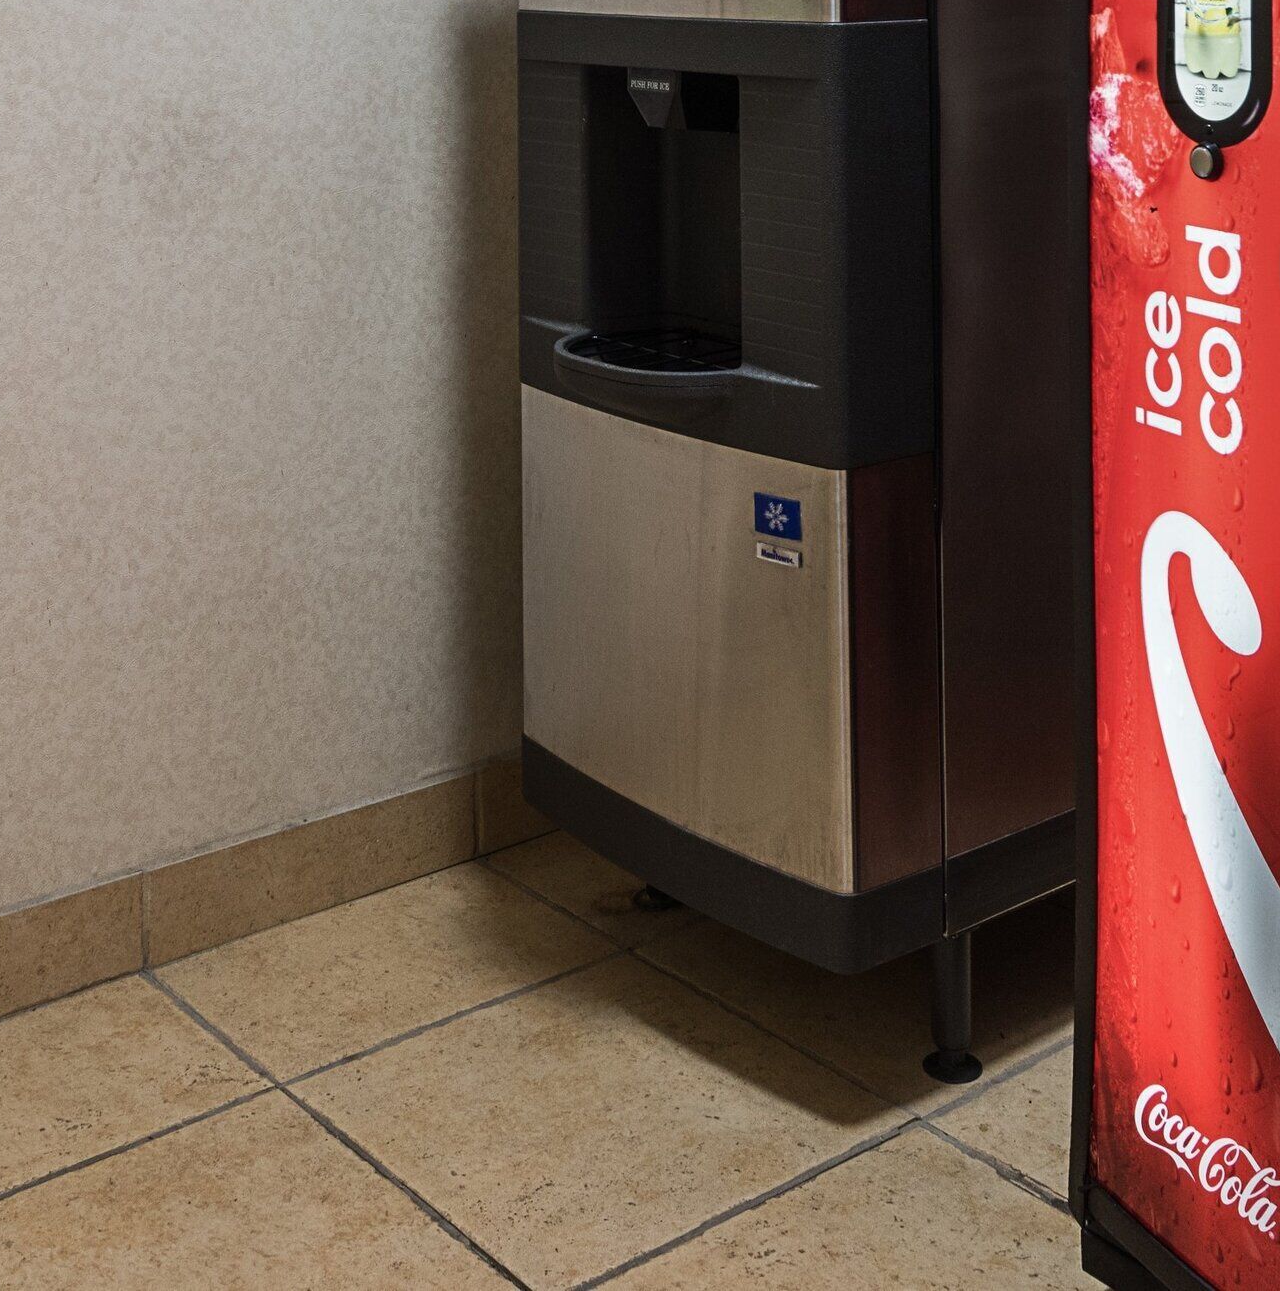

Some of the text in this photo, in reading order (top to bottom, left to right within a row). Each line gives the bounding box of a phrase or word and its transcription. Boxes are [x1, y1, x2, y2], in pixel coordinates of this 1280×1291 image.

[631, 80, 669, 90] PUSH FOR ICE
[1135, 290, 1182, 436] ice
[1185, 224, 1243, 455] cold
